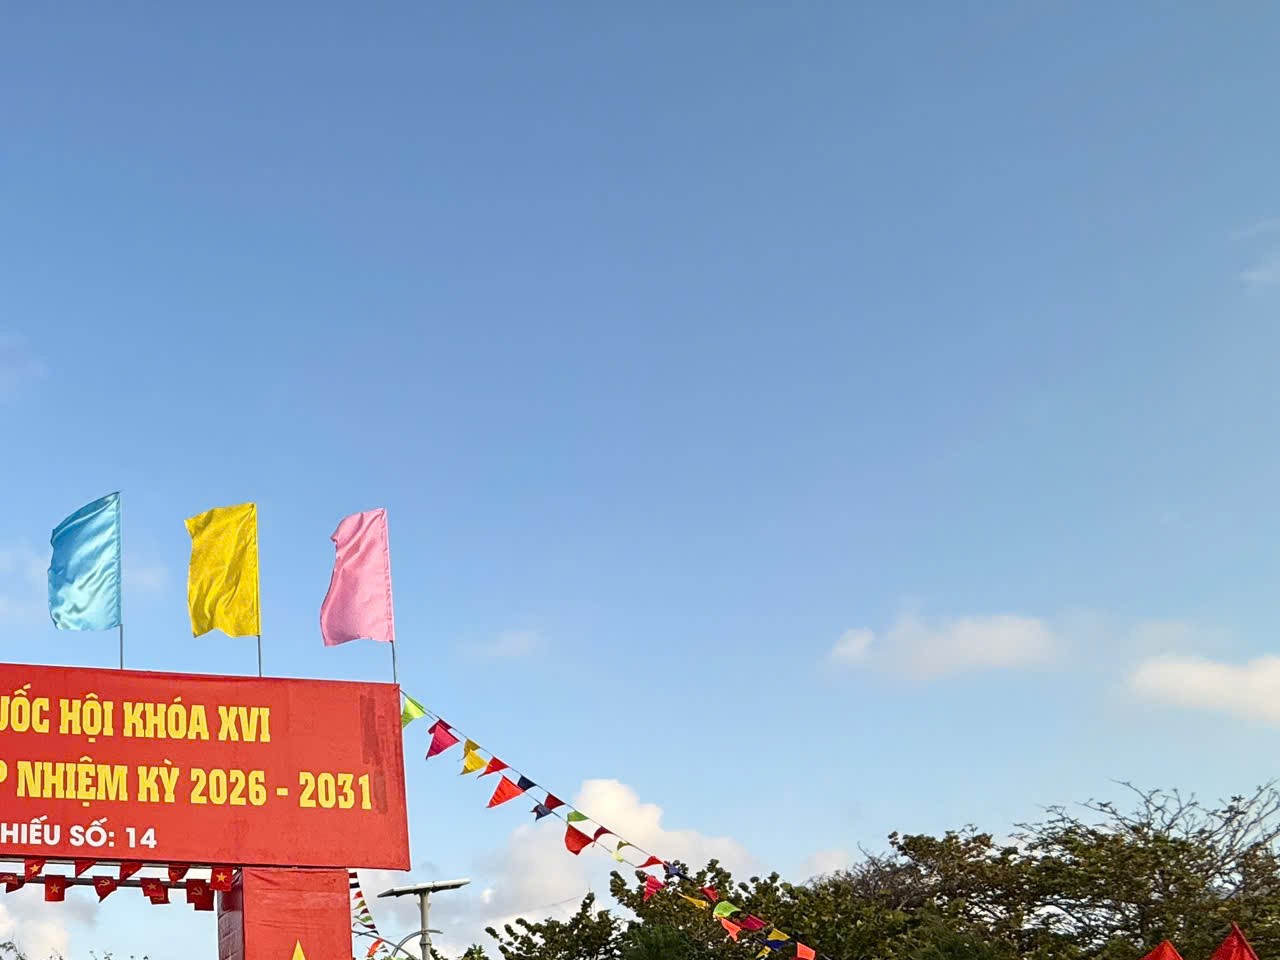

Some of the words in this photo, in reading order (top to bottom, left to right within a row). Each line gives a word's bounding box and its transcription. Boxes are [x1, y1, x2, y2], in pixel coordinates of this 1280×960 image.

[60, 693, 113, 742] HỘI
[123, 696, 209, 740] KHÓA
[218, 706, 270, 742] XVI
[17, 756, 128, 805] NHIỆM
[138, 759, 179, 802] KỲ
[191, 768, 266, 805] 2026
[299, 771, 372, 810] 2031
[70, 819, 114, 846] SỐ:
[126, 827, 157, 848] 14
